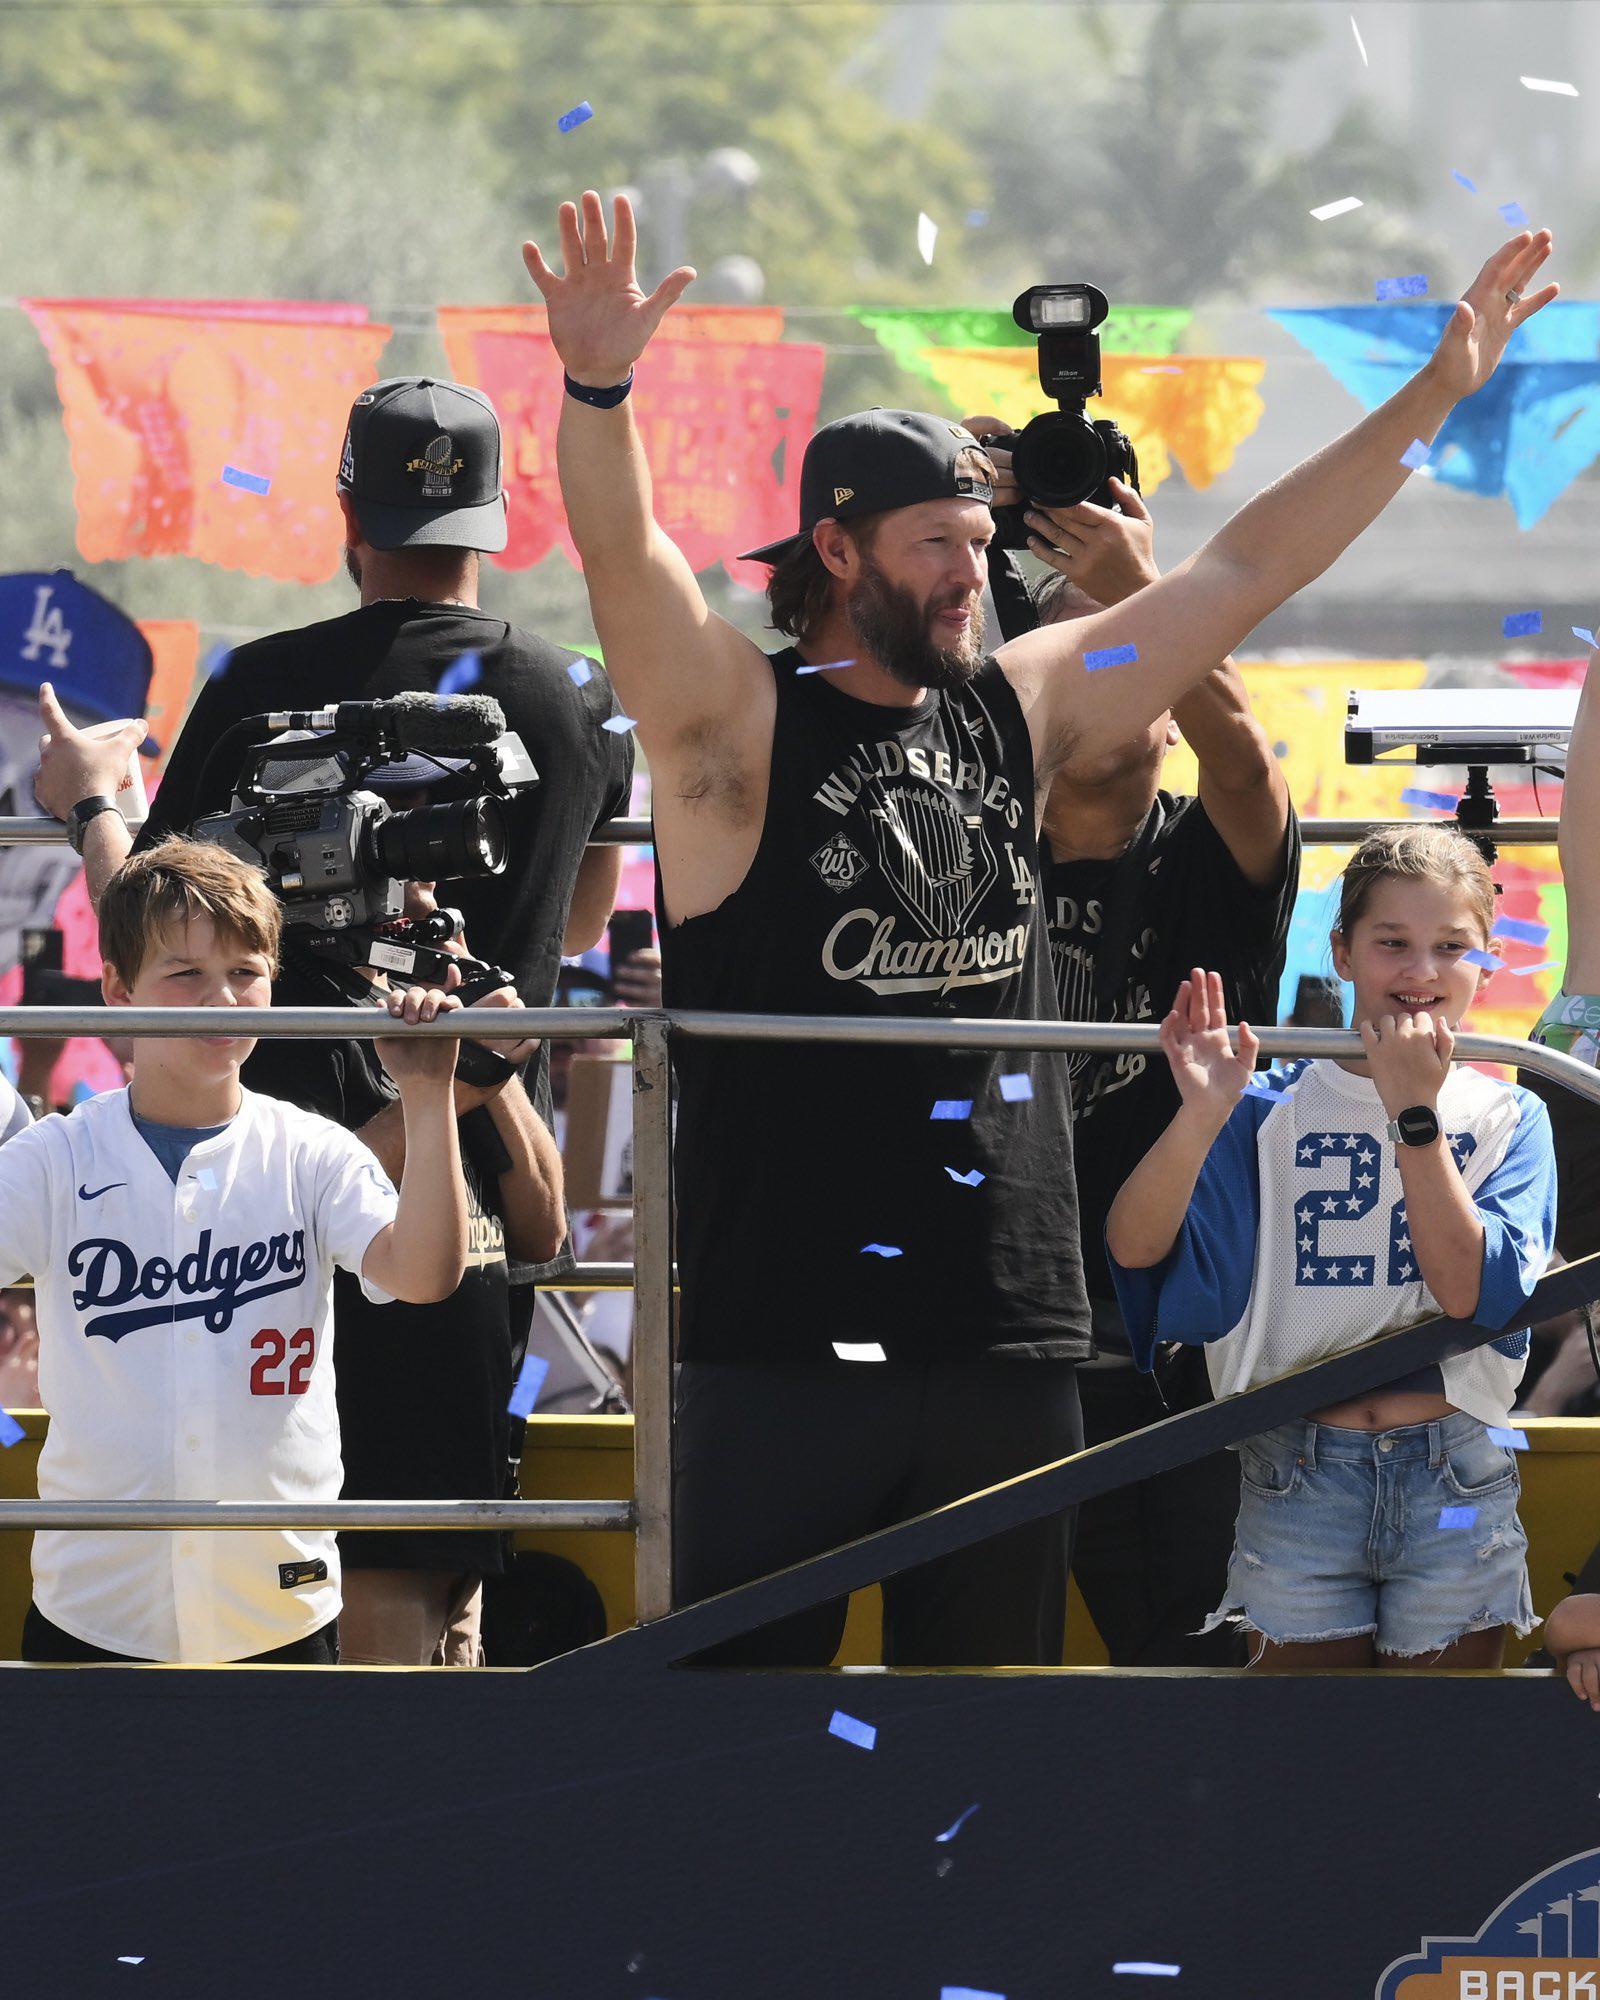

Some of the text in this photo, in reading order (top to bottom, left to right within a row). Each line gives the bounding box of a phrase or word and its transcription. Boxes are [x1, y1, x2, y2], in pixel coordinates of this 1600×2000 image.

[1058, 369, 1078, 377] Nikon
[20, 585, 73, 668] LA
[906, 748, 1023, 829] SERES
[821, 908, 1030, 996] Champion
[68, 1228, 306, 1343] Dodgers
[250, 1327, 315, 1396] 22
[1459, 1970, 1598, 2000] BACK
